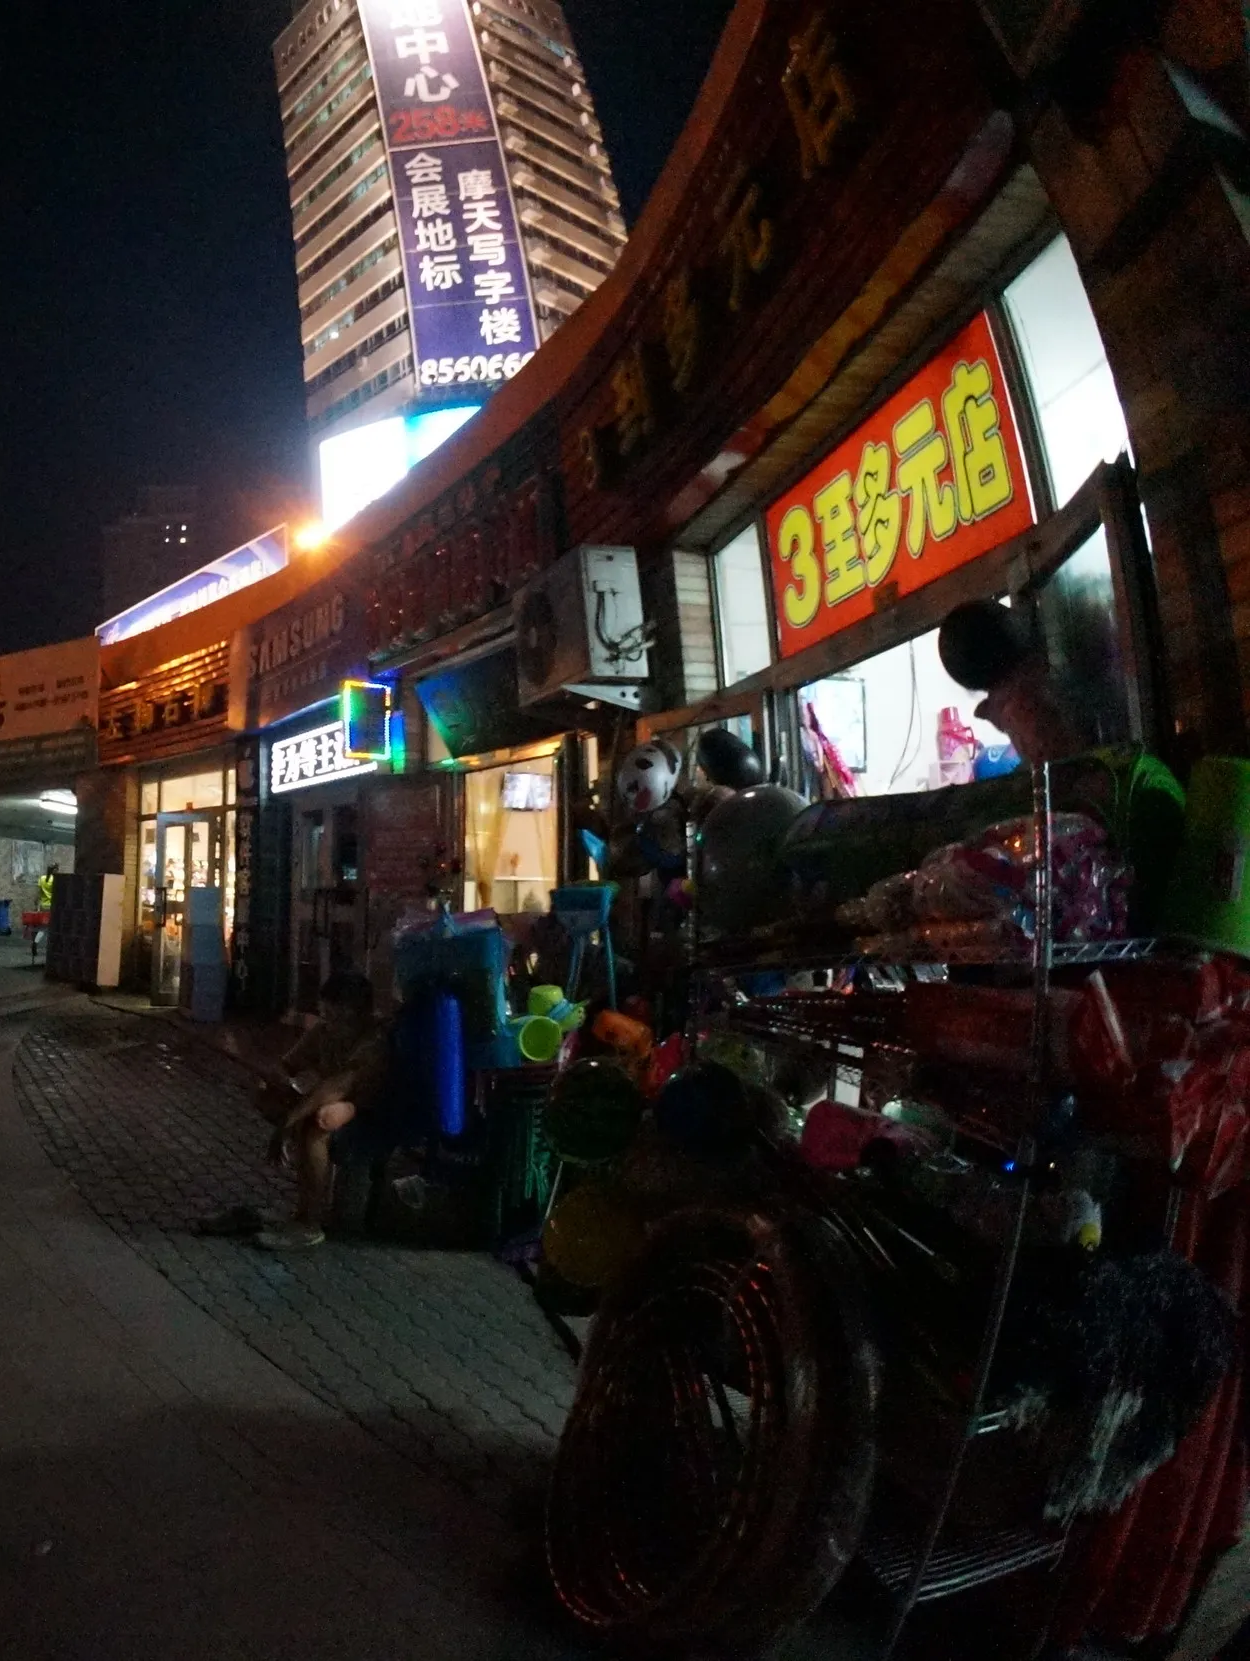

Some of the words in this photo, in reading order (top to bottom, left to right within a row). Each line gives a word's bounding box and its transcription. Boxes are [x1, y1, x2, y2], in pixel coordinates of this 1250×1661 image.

[405, 152, 463, 292] 会展地标
[457, 168, 522, 346] 摩天写字楼
[249, 591, 347, 680] SAMSUNG
